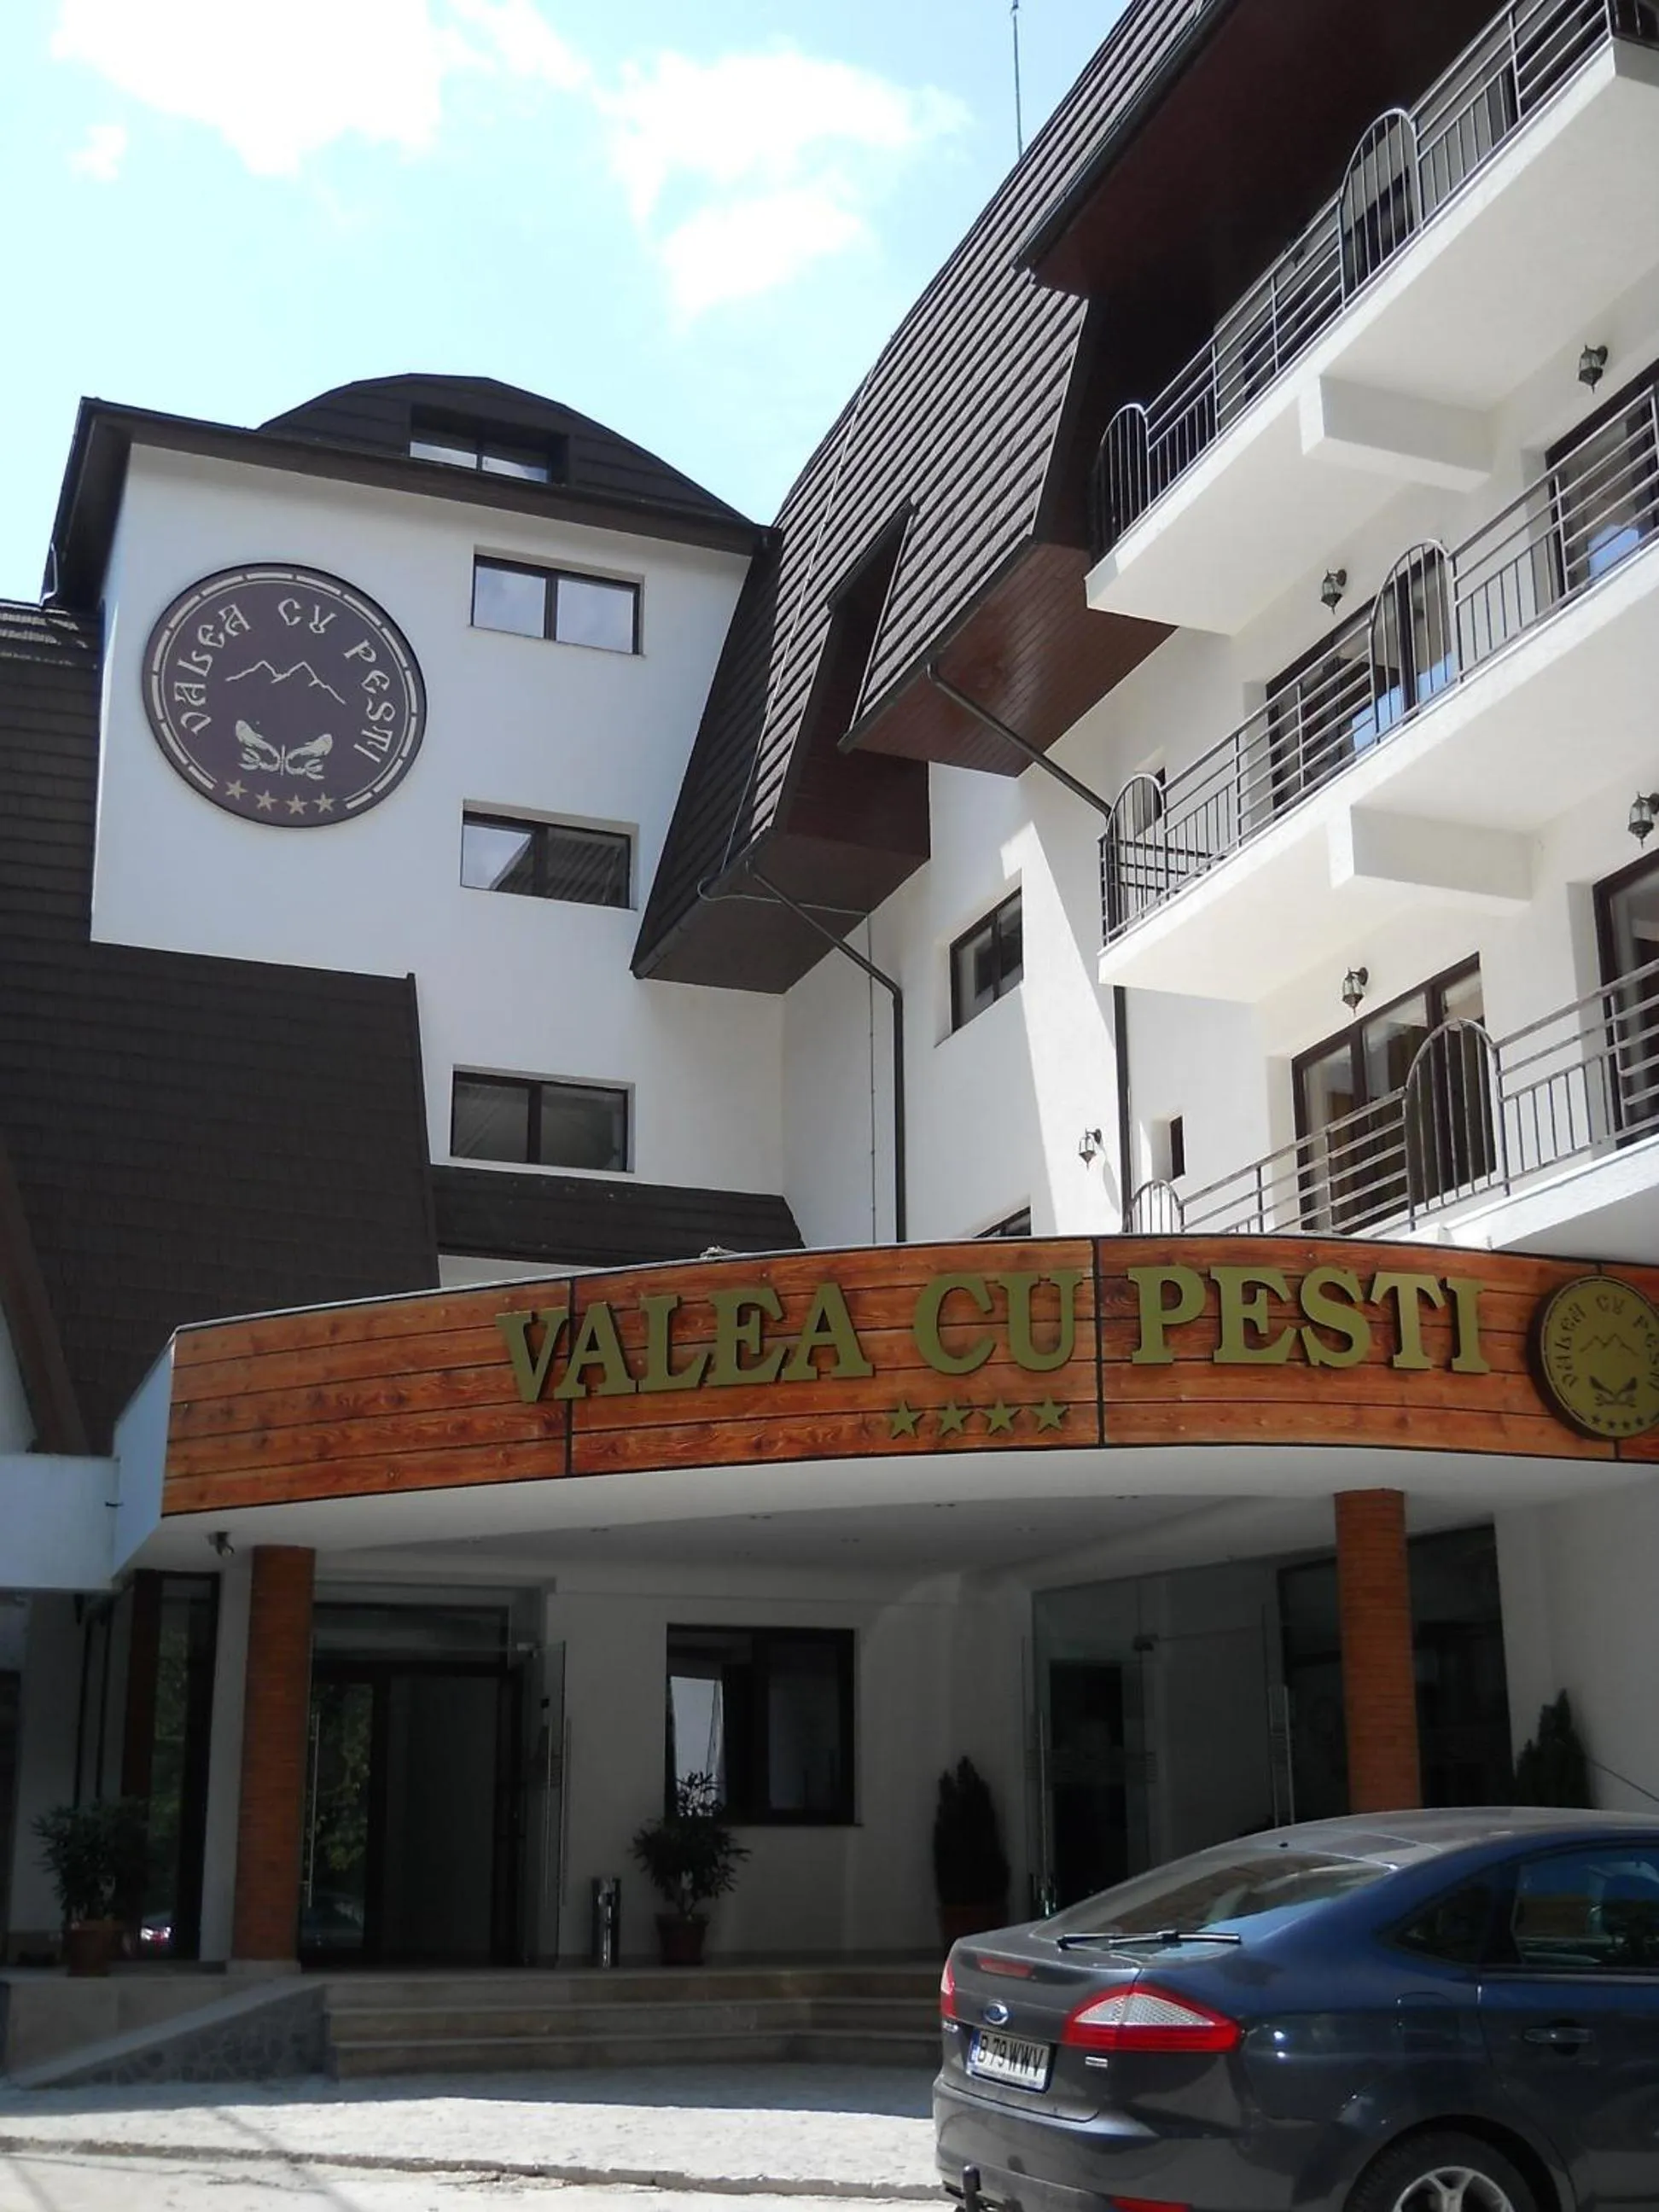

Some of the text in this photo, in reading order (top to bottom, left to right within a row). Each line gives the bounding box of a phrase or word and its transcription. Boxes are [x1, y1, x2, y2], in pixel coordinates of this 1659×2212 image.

[496, 1266, 1489, 1403] VALEA CU PESTI
